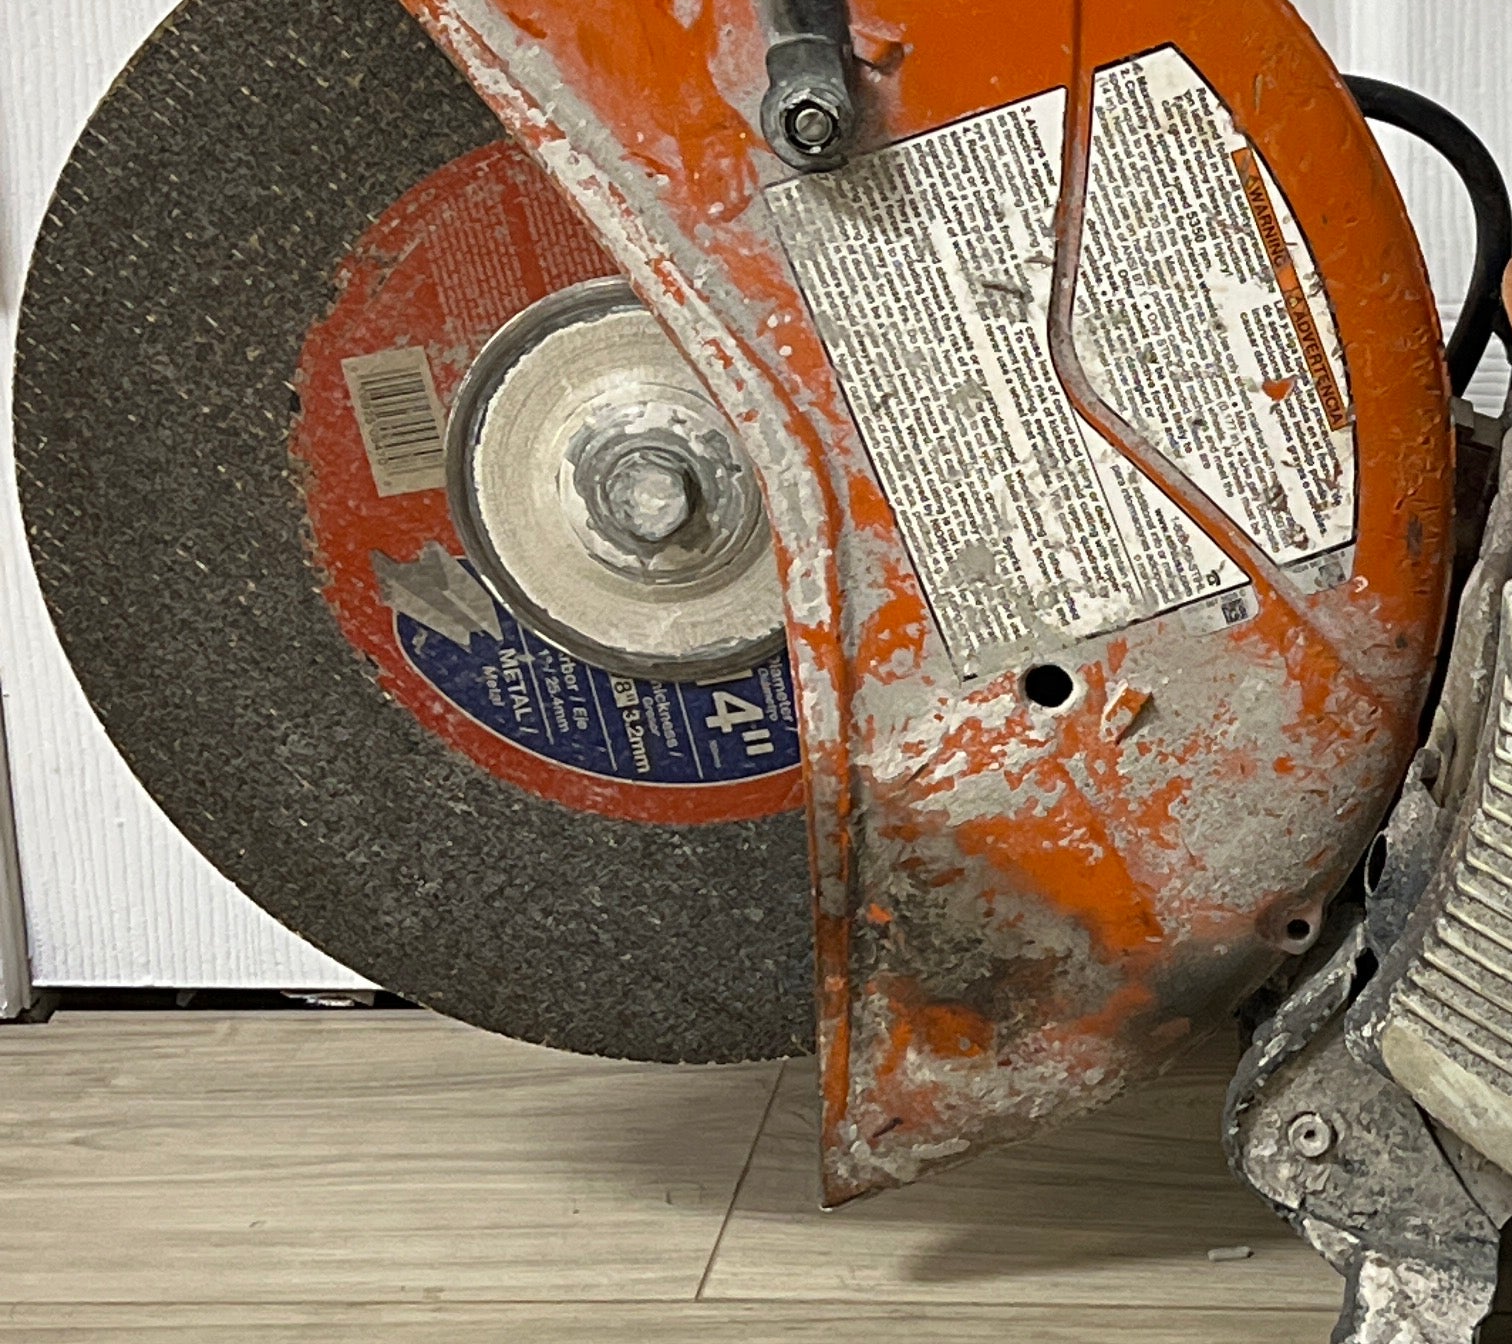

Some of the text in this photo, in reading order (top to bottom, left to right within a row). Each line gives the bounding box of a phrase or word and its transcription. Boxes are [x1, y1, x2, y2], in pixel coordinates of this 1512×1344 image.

[1185, 209, 1207, 244] 5350
[1247, 186, 1288, 267] WARNING
[1291, 308, 1346, 426] ADVERTENCIA
[497, 646, 533, 722] METAL
[544, 674, 571, 734] 25.4mm
[556, 649, 581, 693] rbor
[620, 706, 654, 774] 3.2mm
[649, 677, 681, 748] hickness
